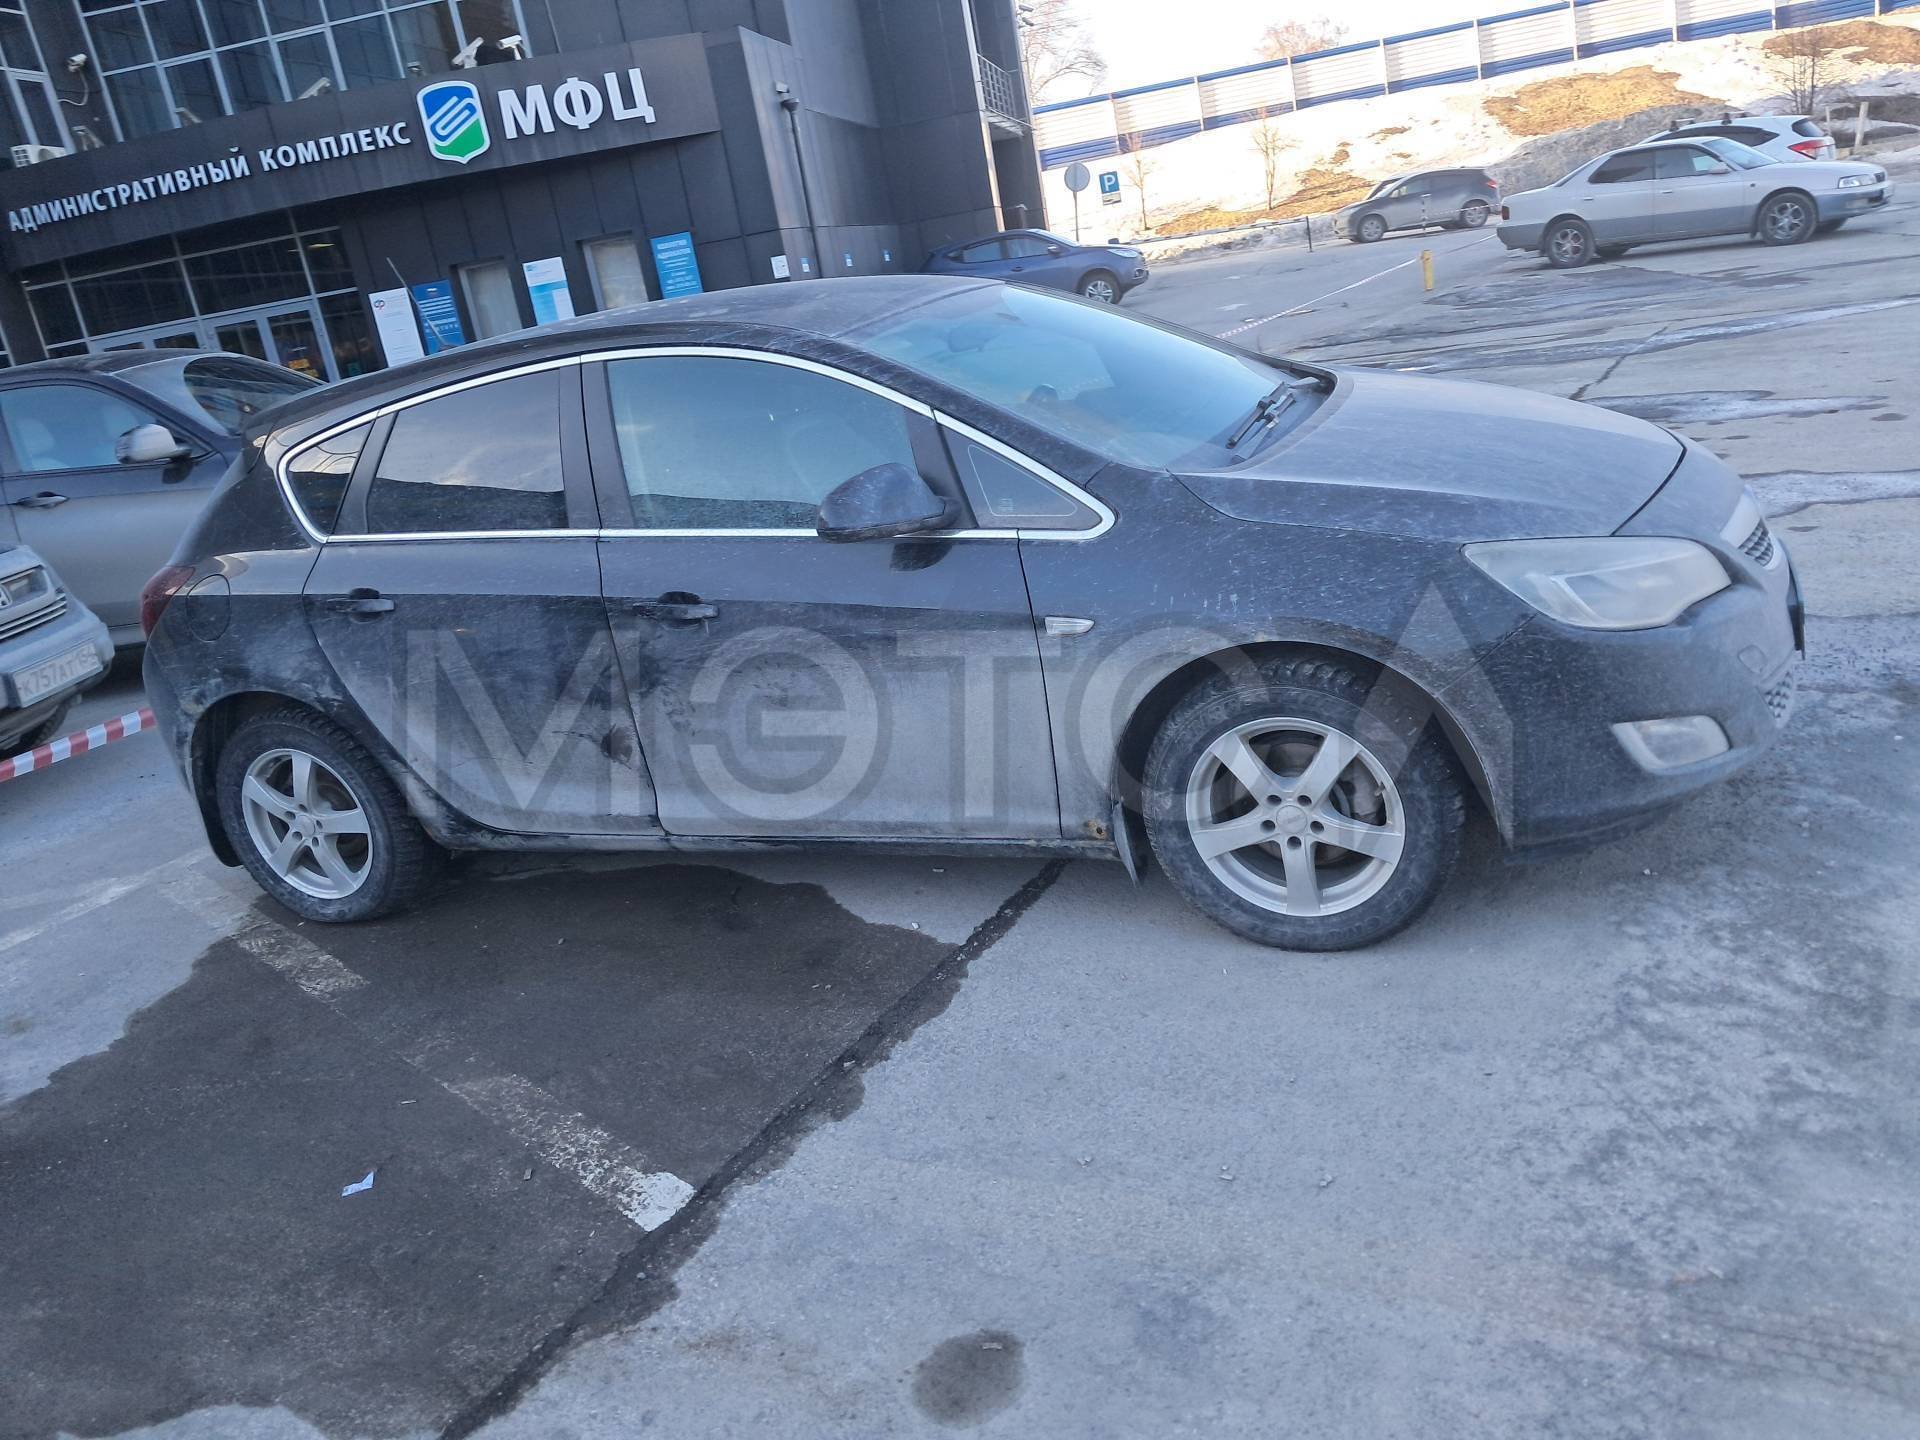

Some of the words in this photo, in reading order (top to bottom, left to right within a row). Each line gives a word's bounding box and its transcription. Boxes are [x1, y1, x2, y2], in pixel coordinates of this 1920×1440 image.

[8, 146, 251, 233] АДМИНИСТРАТИВНЫЙ
[259, 121, 412, 172] КОМПЛЕКС
[497, 67, 657, 140] МФЦ
[1103, 174, 1116, 192] P
